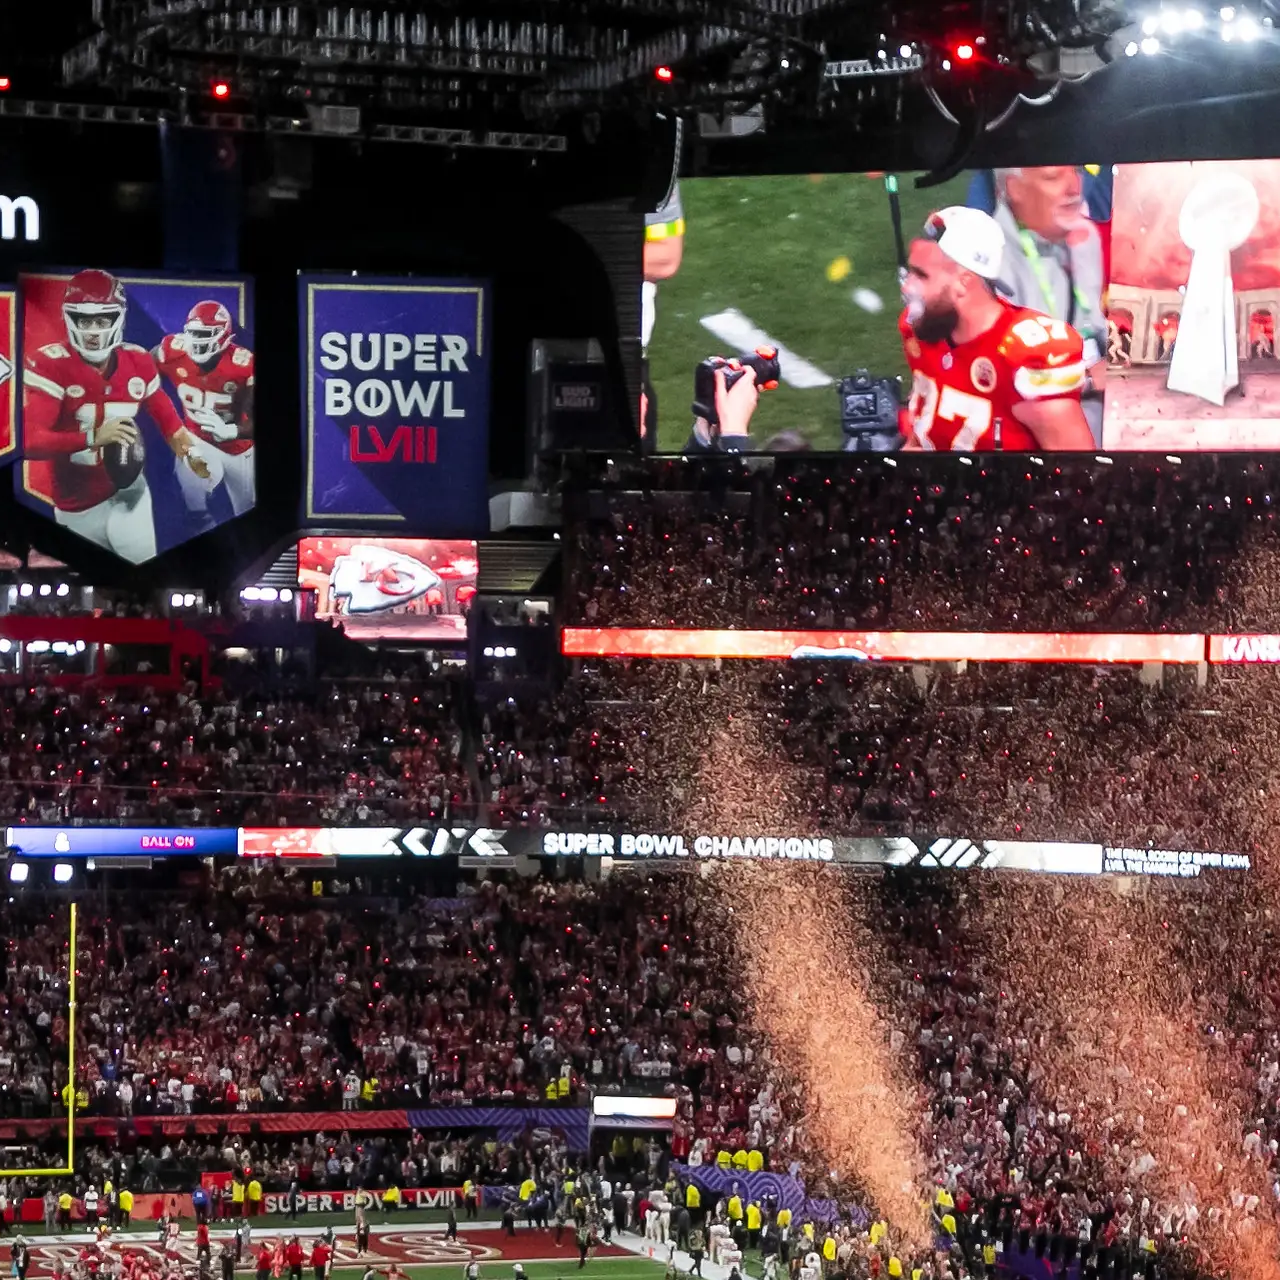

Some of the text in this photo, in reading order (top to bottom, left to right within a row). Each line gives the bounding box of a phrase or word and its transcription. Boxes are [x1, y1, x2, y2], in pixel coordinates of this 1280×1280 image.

[320, 331, 468, 374] SUPER
[325, 378, 465, 418] BOWL
[350, 425, 438, 463] LVIII
[141, 835, 195, 848] BALL ON
[543, 832, 834, 861] SUPER BOWL CHAMPIONS
[264, 1193, 333, 1214] SUPER
